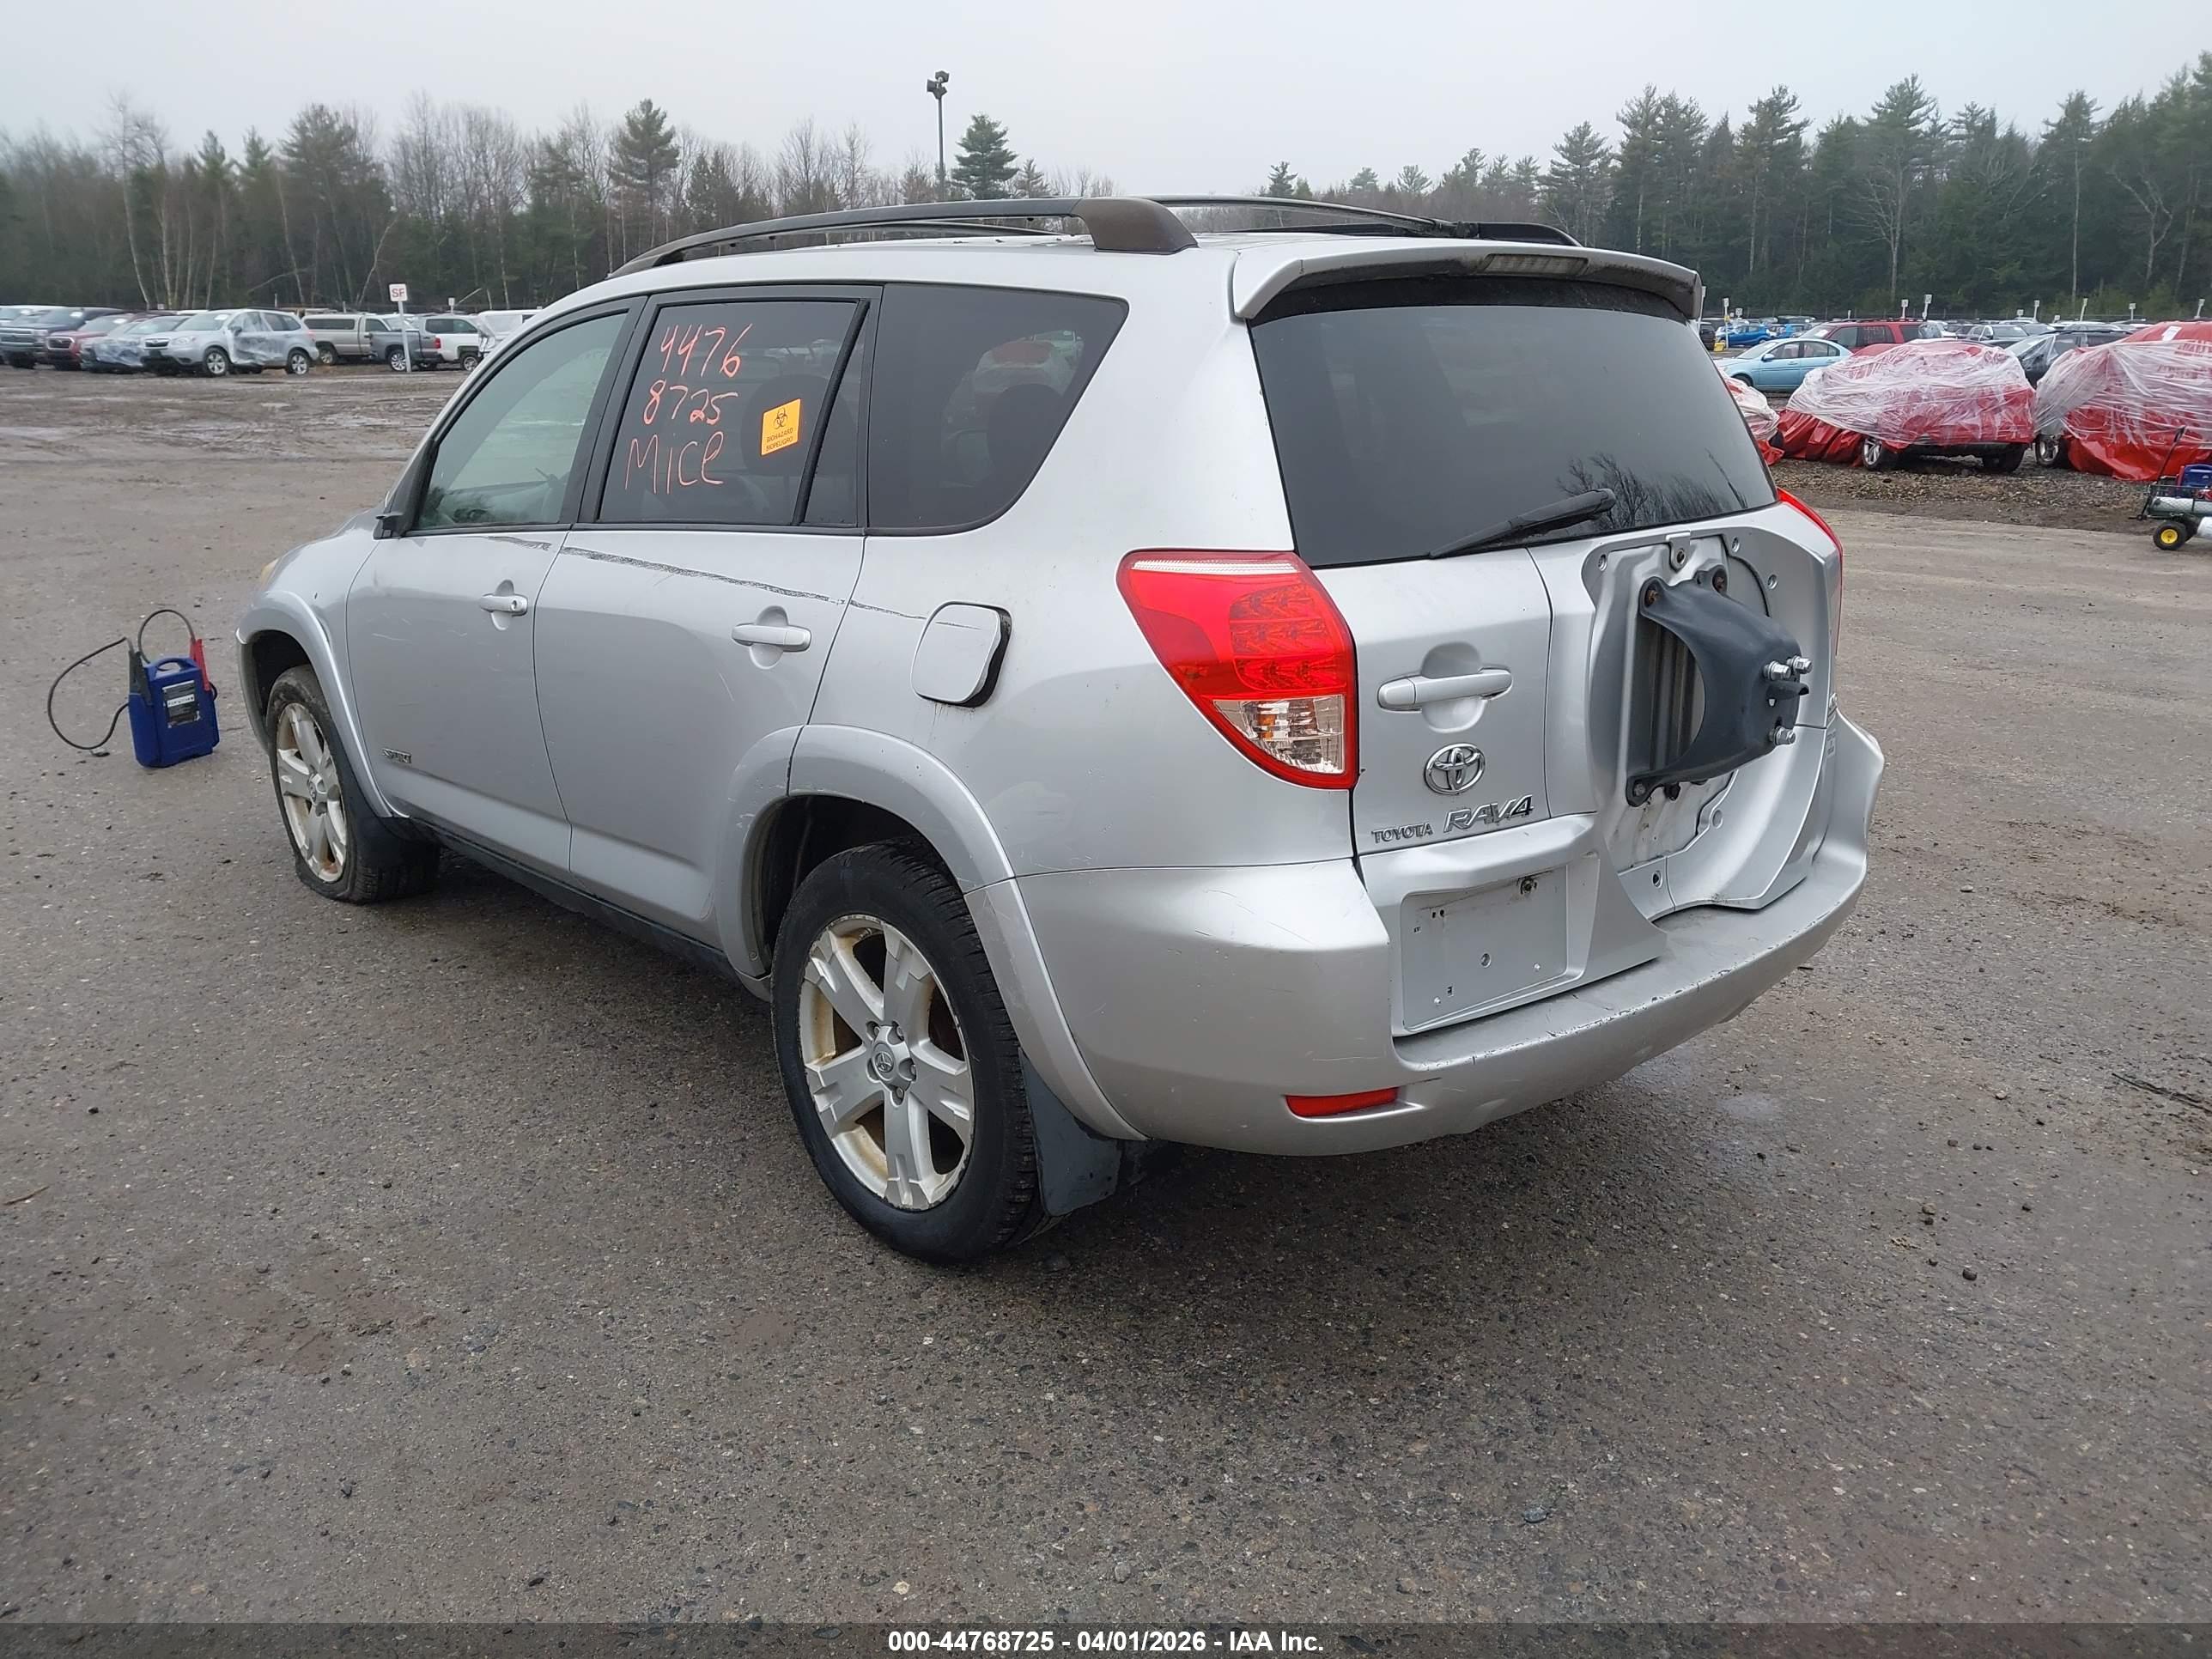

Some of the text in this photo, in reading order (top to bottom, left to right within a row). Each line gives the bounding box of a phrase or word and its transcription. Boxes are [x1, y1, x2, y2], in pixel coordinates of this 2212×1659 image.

[660, 323, 752, 378] 4476
[642, 379, 738, 426] 8725
[766, 428, 793, 443] BIOHAZARD
[1371, 794, 1534, 844] TOYOTA RAV4
